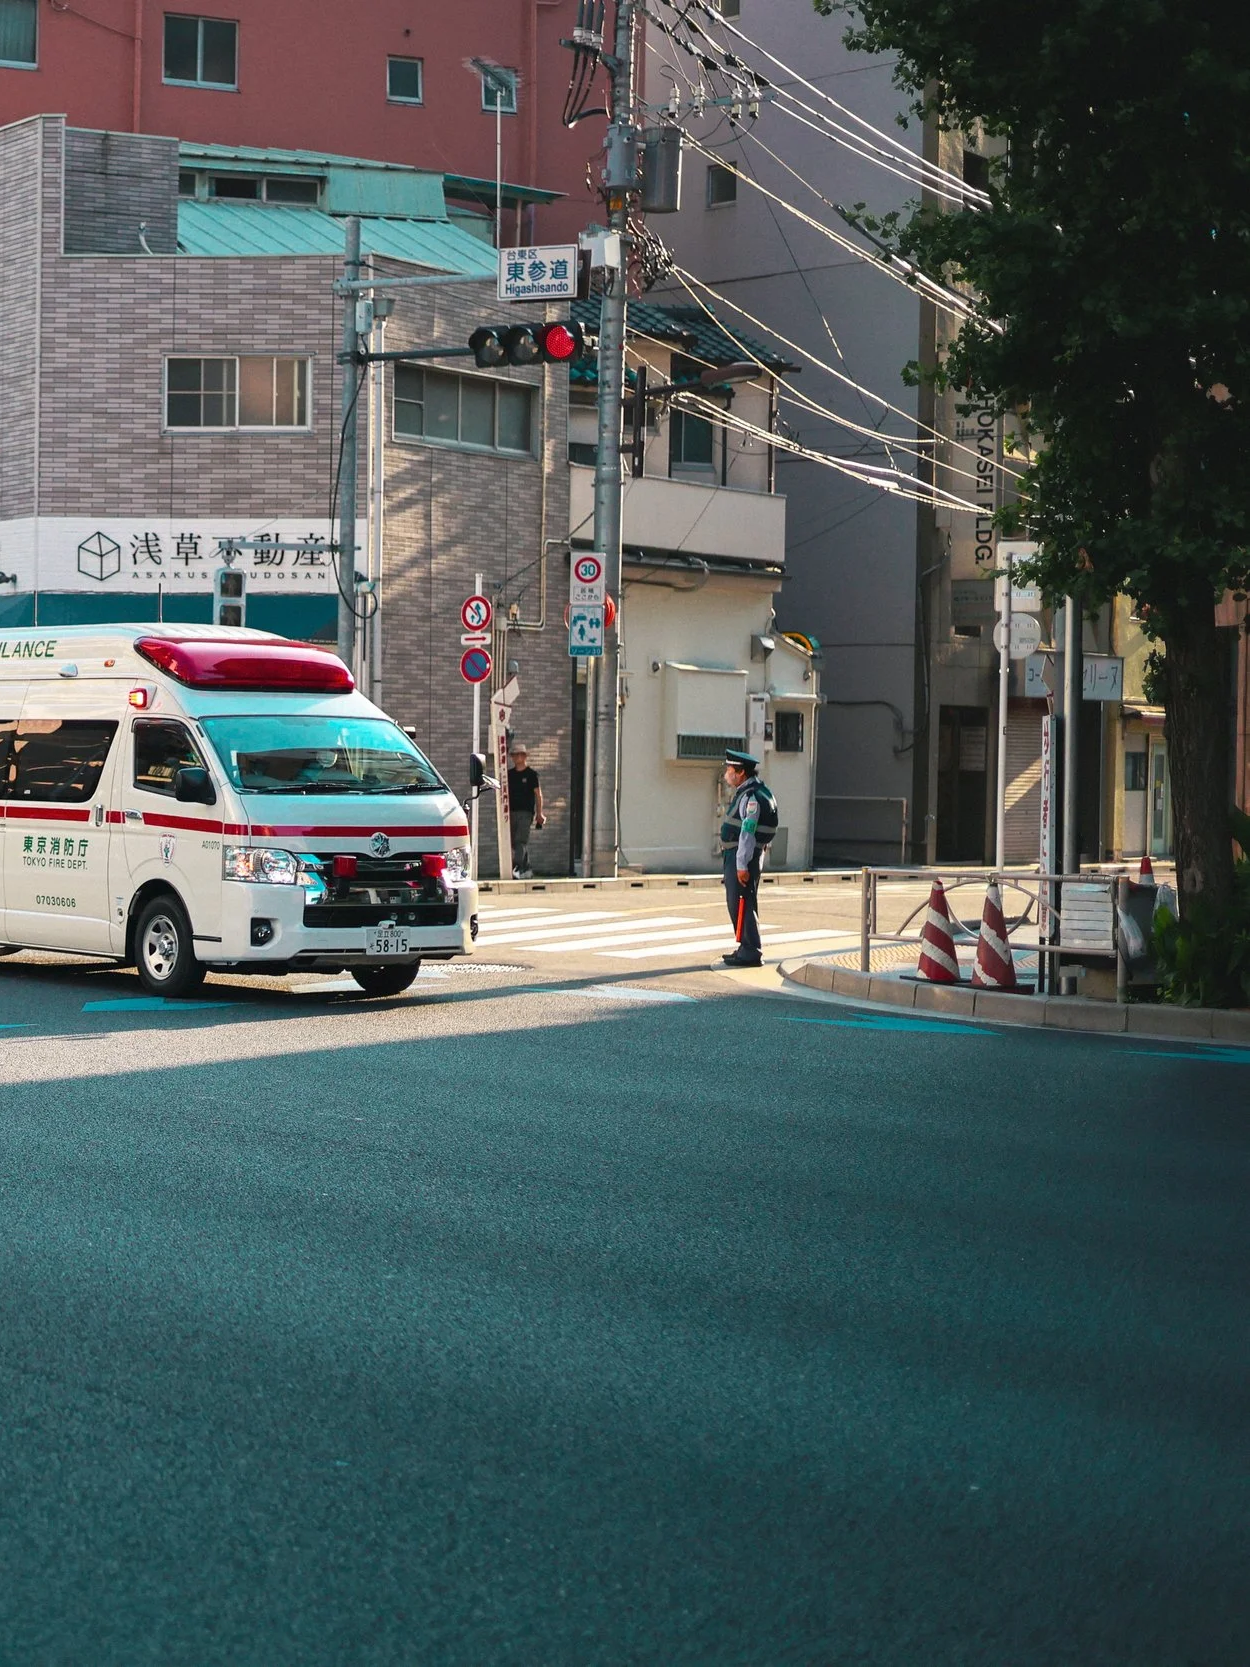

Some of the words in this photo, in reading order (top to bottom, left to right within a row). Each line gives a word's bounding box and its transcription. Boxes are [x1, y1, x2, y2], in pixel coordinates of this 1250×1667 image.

[507, 249, 538, 261] 台東区
[506, 259, 569, 282] 東参道
[505, 281, 569, 297] Higashisando
[580, 564, 596, 577] 30
[23, 836, 89, 857] 東京消防庁
[23, 856, 46, 867] TOKYO
[49, 858, 65, 869] FIRE
[67, 859, 88, 870] DEPT.
[36, 895, 77, 908] 07030606
[376, 939, 408, 952] 58-15
